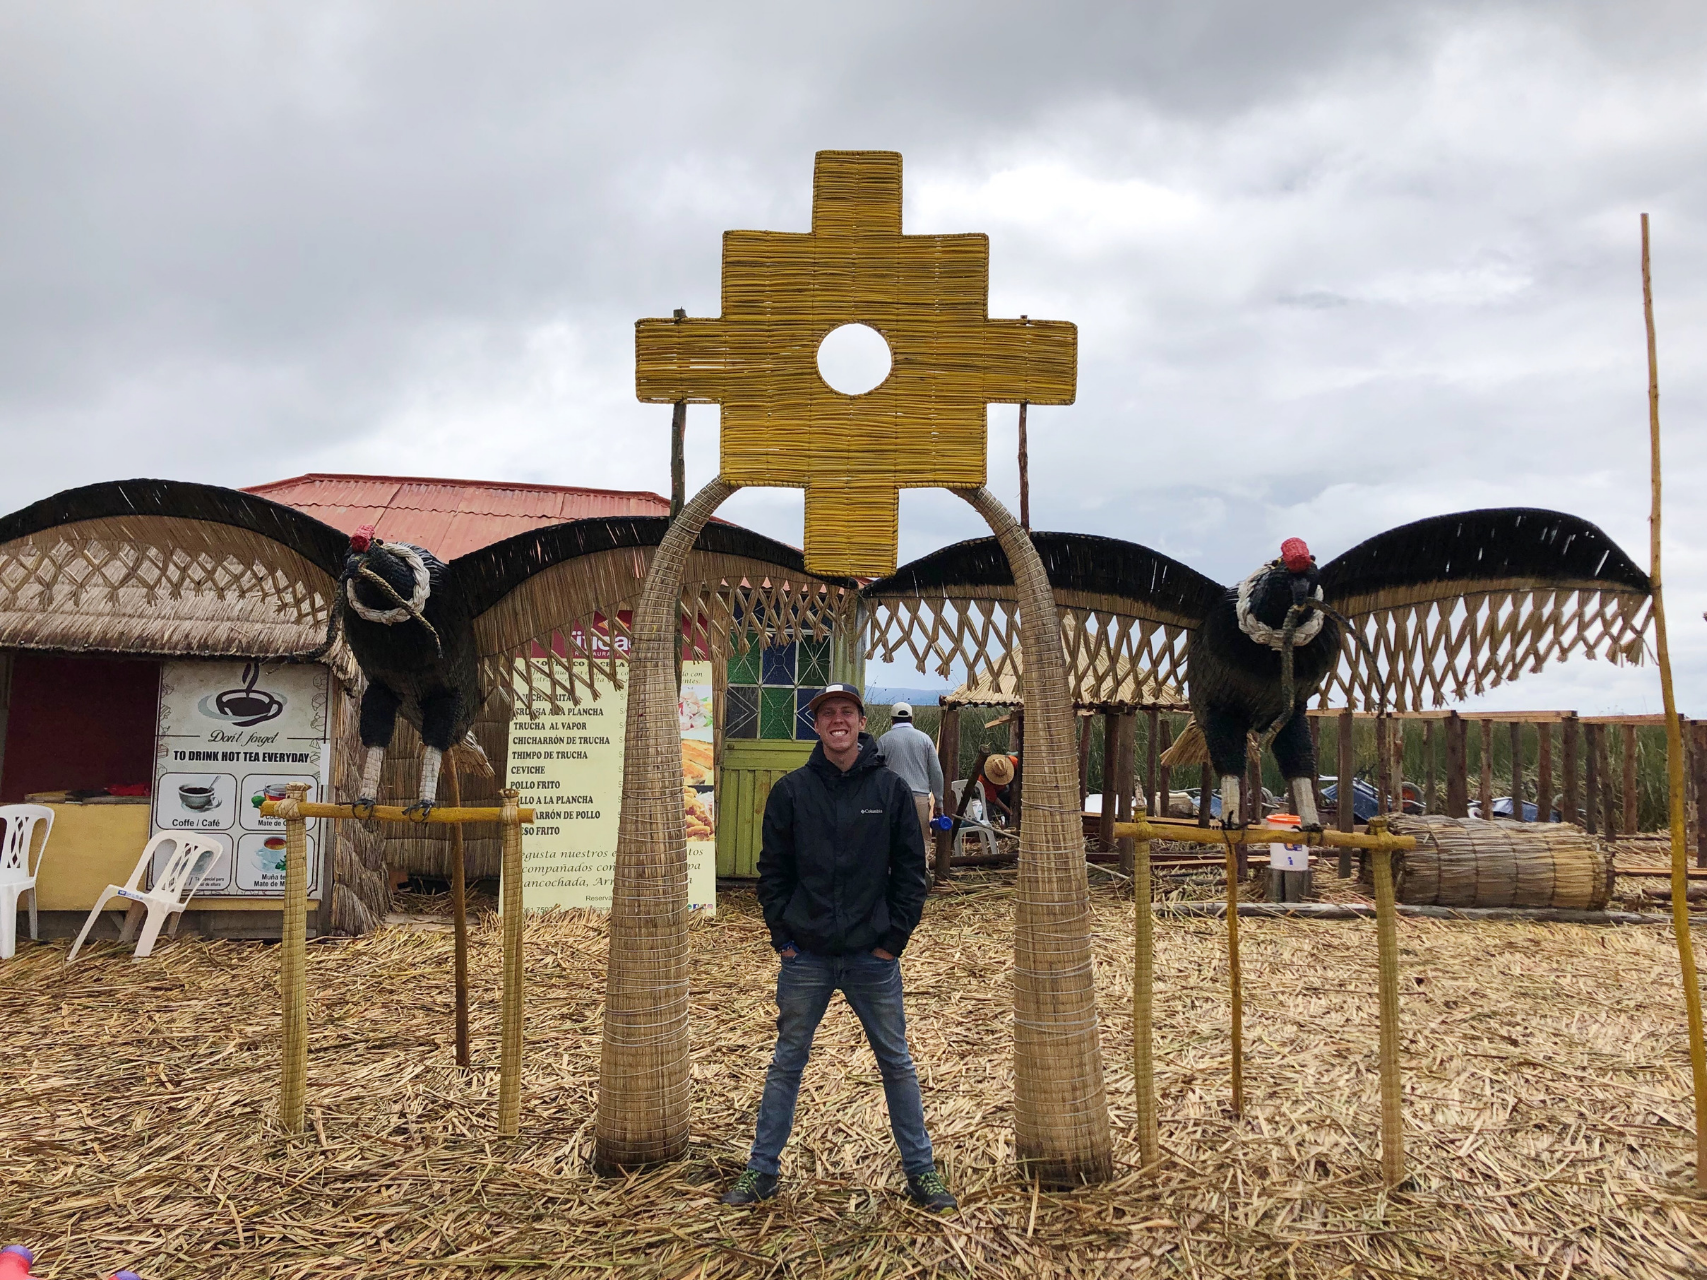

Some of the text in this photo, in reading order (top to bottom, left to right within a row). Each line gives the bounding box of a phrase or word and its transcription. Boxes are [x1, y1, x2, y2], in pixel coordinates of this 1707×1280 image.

[567, 708, 604, 716] PLANCHA
[514, 722, 587, 730] TRUCHA AL VAPOR
[241, 731, 280, 748] forget
[512, 735, 564, 745] CHICHARRÓN
[578, 737, 610, 745] TRUCHA
[174, 750, 310, 763] TO DRINK HOT TEA EVERYDAY
[512, 751, 588, 759] THIMPO DE TRUCHA
[511, 766, 546, 774] CEVICHE
[510, 781, 560, 789] POLLO FRITO
[536, 796, 543, 804] A
[544, 796, 555, 804] LA
[556, 795, 593, 804] PLANCHA
[563, 811, 575, 819] DE
[576, 811, 600, 819] POLLO
[172, 818, 195, 827] Coffe
[201, 818, 220, 827] Café
[258, 819, 273, 827] Mate
[536, 827, 560, 836] FRITO
[560, 849, 608, 859] nuestros
